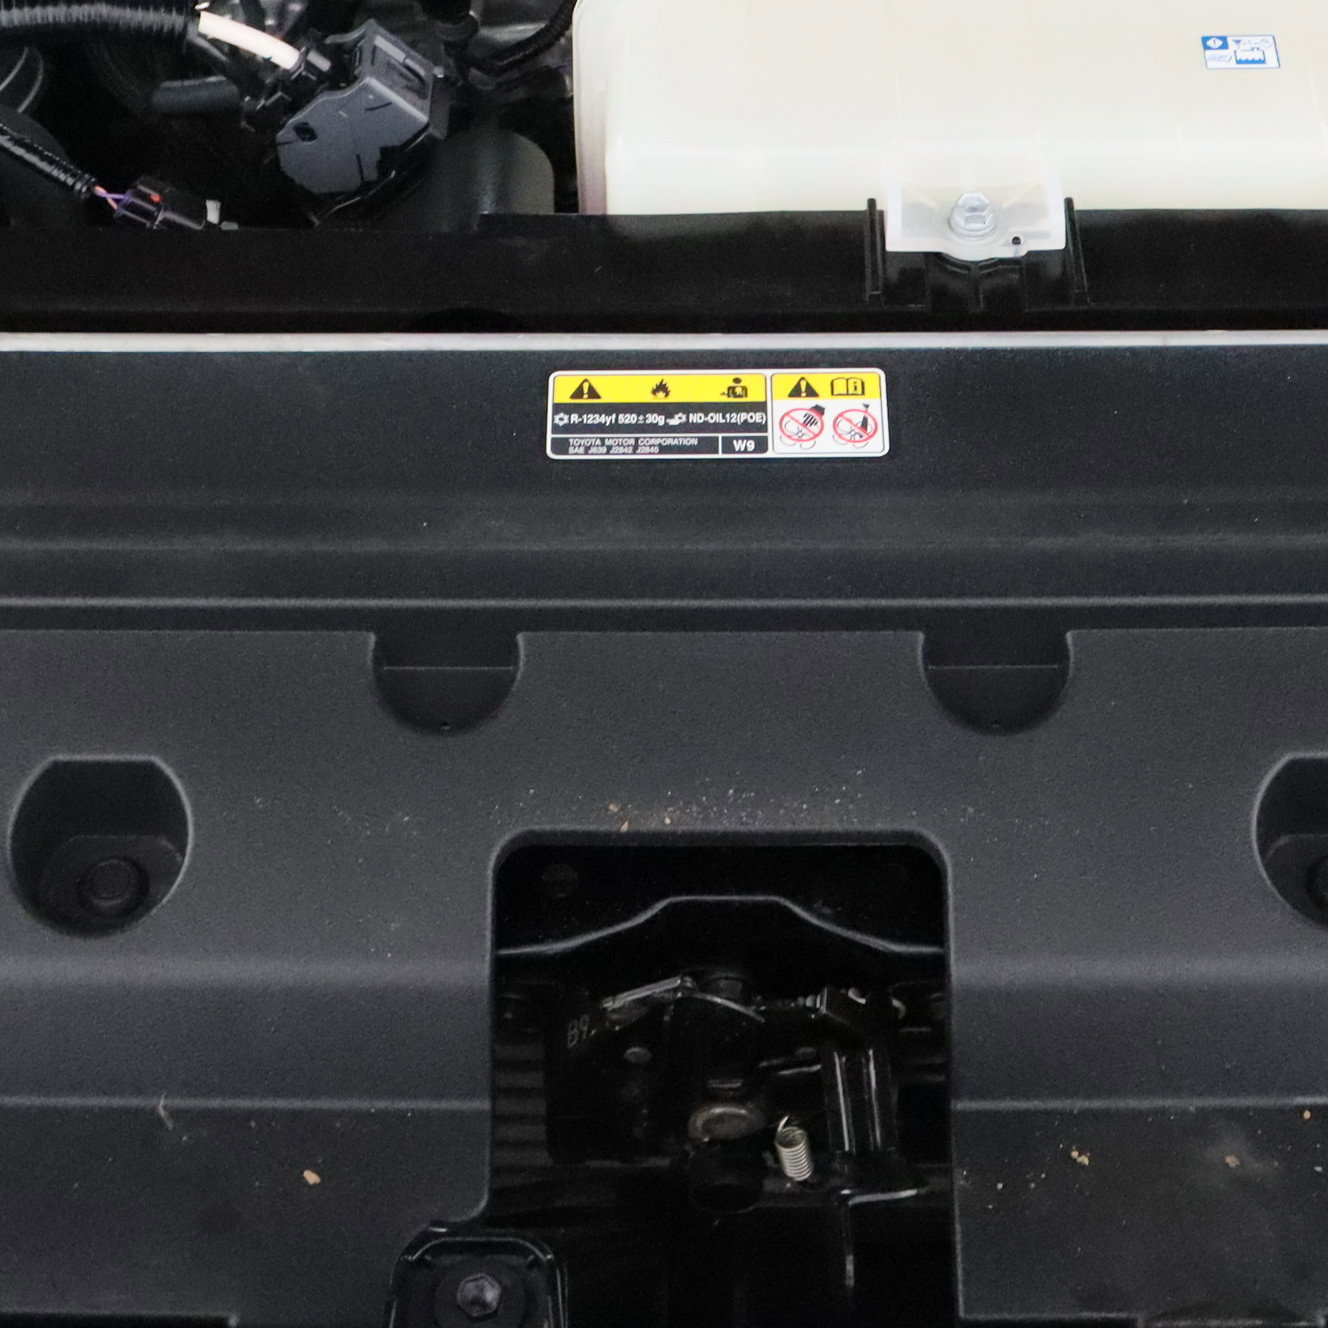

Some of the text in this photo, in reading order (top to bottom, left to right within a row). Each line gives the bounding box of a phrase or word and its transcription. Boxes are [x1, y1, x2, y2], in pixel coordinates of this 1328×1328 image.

[570, 413, 616, 426] R-1234yf
[688, 412, 766, 425] ND-OIL12(POE)
[568, 437, 698, 446] TOYOTA MOTOR CORPORATION
[732, 439, 755, 452] W9
[568, 446, 585, 454] SAE
